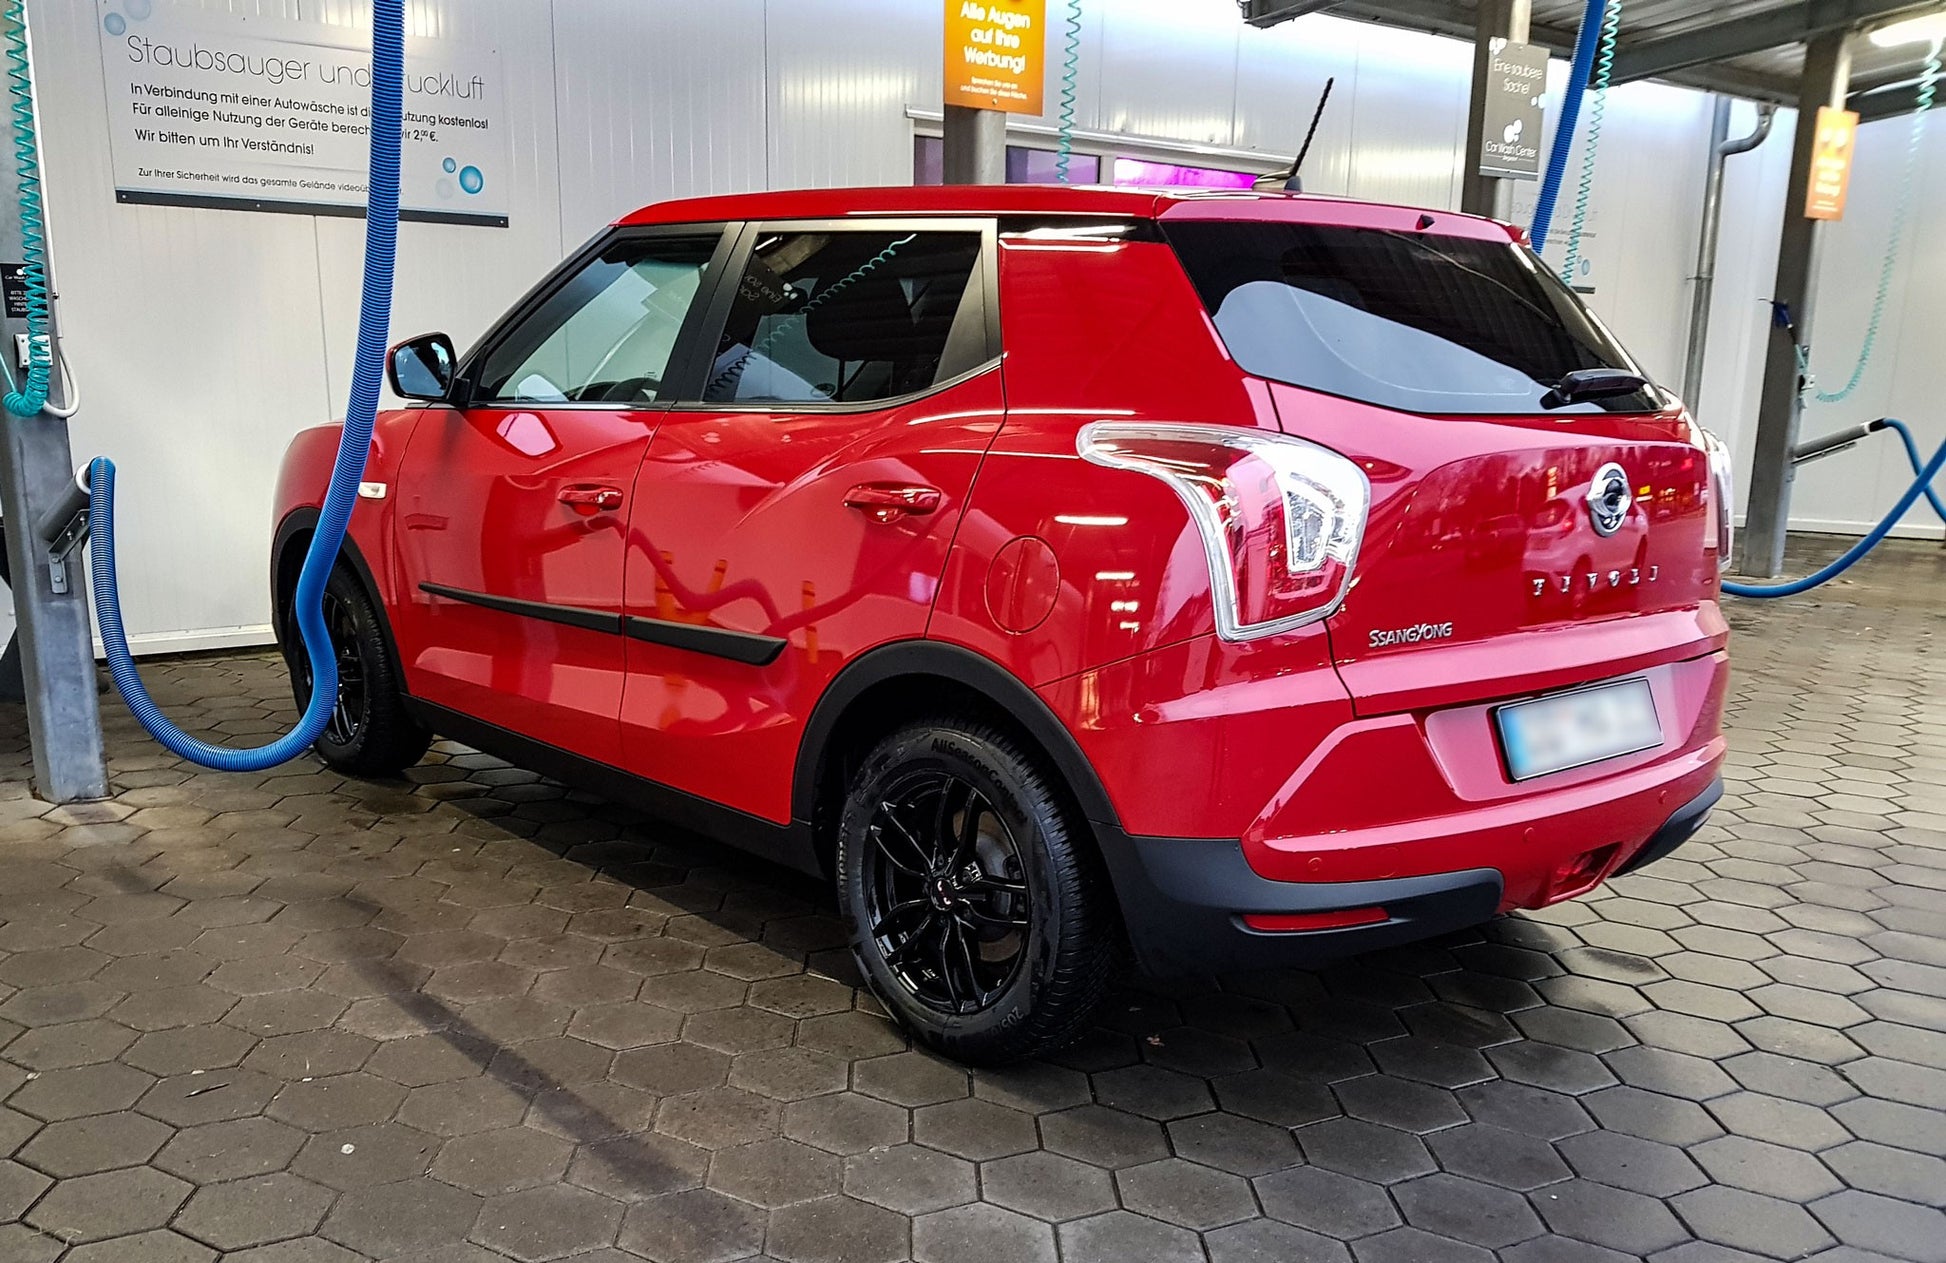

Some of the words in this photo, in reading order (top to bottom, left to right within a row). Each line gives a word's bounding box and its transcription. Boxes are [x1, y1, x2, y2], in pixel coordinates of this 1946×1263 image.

[960, 1, 986, 22] Alle
[987, 6, 1031, 30] Augen
[970, 27, 994, 45] auf
[995, 29, 1020, 49] Ihre
[127, 35, 311, 85] Staubsauger
[319, 63, 371, 88] und
[403, 71, 485, 100] uckluft
[963, 46, 1026, 74] Werbung!
[130, 83, 142, 95] In
[143, 84, 217, 104] Verbindung
[220, 92, 239, 104] mit
[241, 94, 271, 107] einer
[273, 97, 345, 115] Autowäsche
[347, 104, 358, 116] ist
[360, 106, 371, 117] di
[402, 111, 436, 126] utzung
[438, 114, 489, 129] kostenlos!
[132, 102, 151, 116] Für
[154, 105, 210, 122] alleinige
[212, 110, 262, 128] Nutzung
[265, 115, 285, 128] der
[288, 117, 329, 132] Geräte
[134, 128, 155, 142] Wir
[158, 131, 196, 145] bitten
[199, 136, 220, 148] um
[223, 136, 239, 148] Ihr
[241, 137, 314, 155] Verständnis!
[138, 167, 152, 177] Zur
[154, 168, 174, 179] Ihrer
[176, 170, 220, 182] Sicherheit
[221, 174, 240, 184] wird
[242, 175, 258, 185] das
[260, 178, 298, 189] gesamte
[299, 179, 336, 191] Gelände
[1532, 565, 1659, 596] TIVOLI
